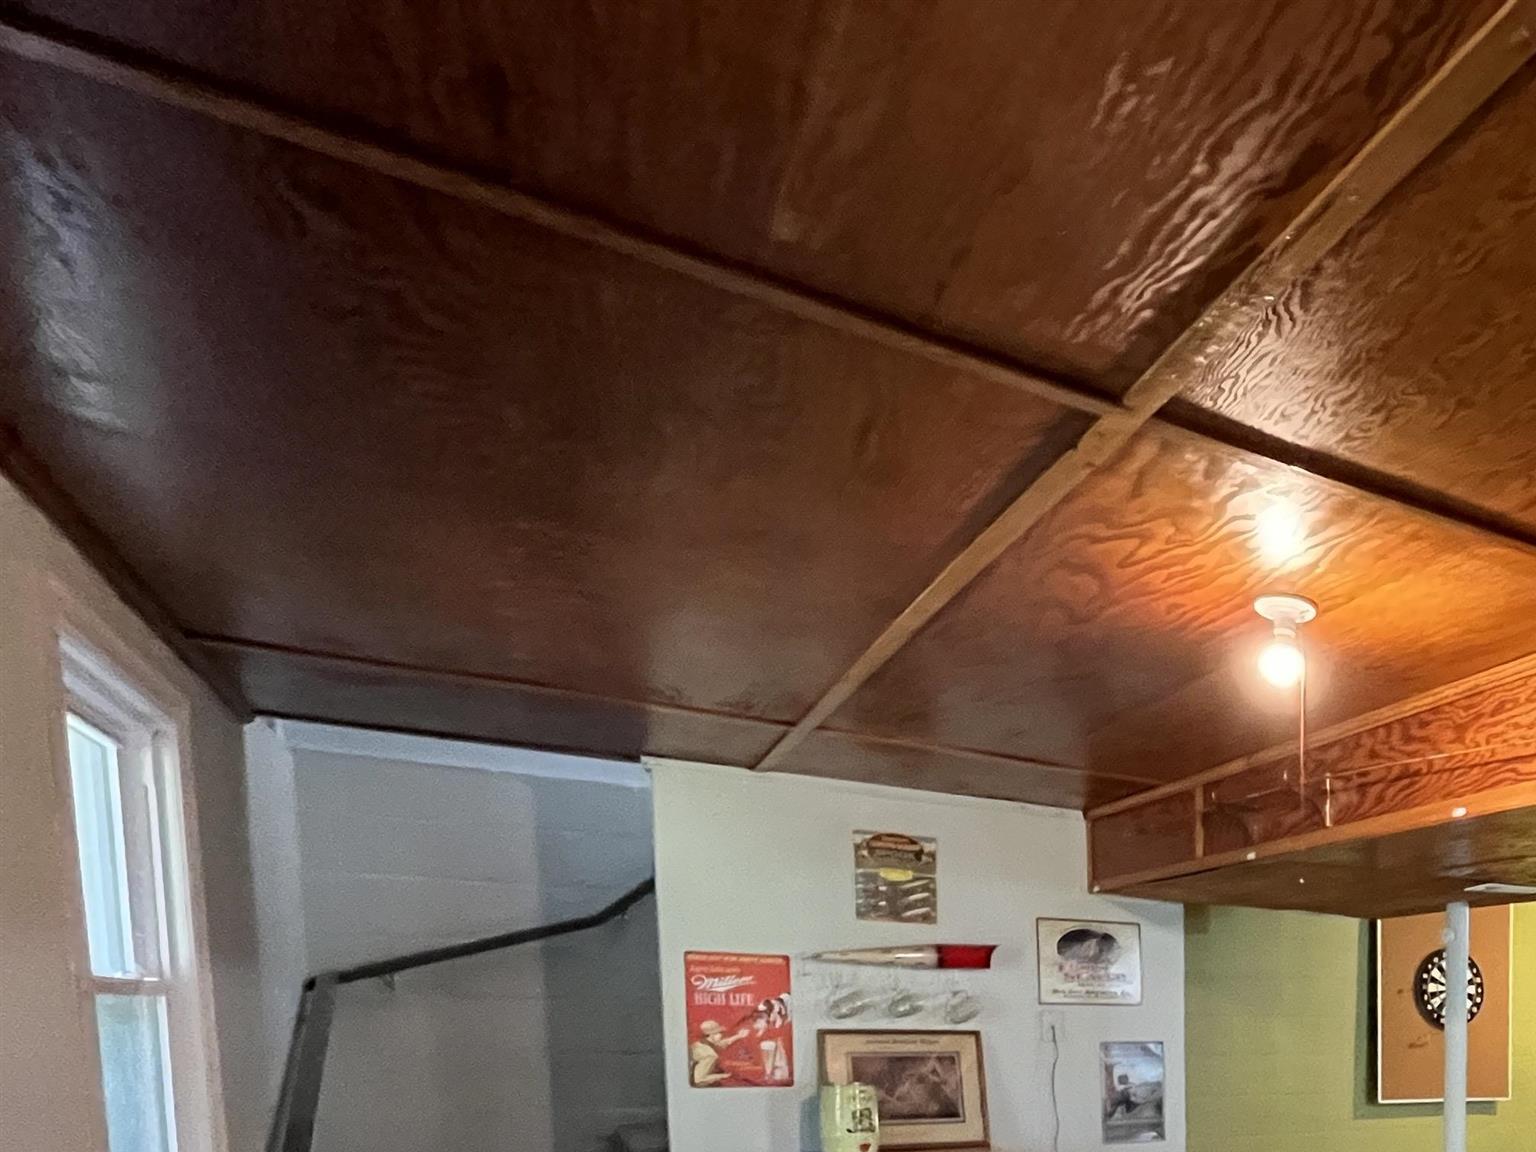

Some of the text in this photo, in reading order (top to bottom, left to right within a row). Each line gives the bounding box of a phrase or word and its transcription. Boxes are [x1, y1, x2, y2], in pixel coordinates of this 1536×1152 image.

[691, 974, 757, 992] Miller
[694, 992, 755, 1006] HIGH LIFE
